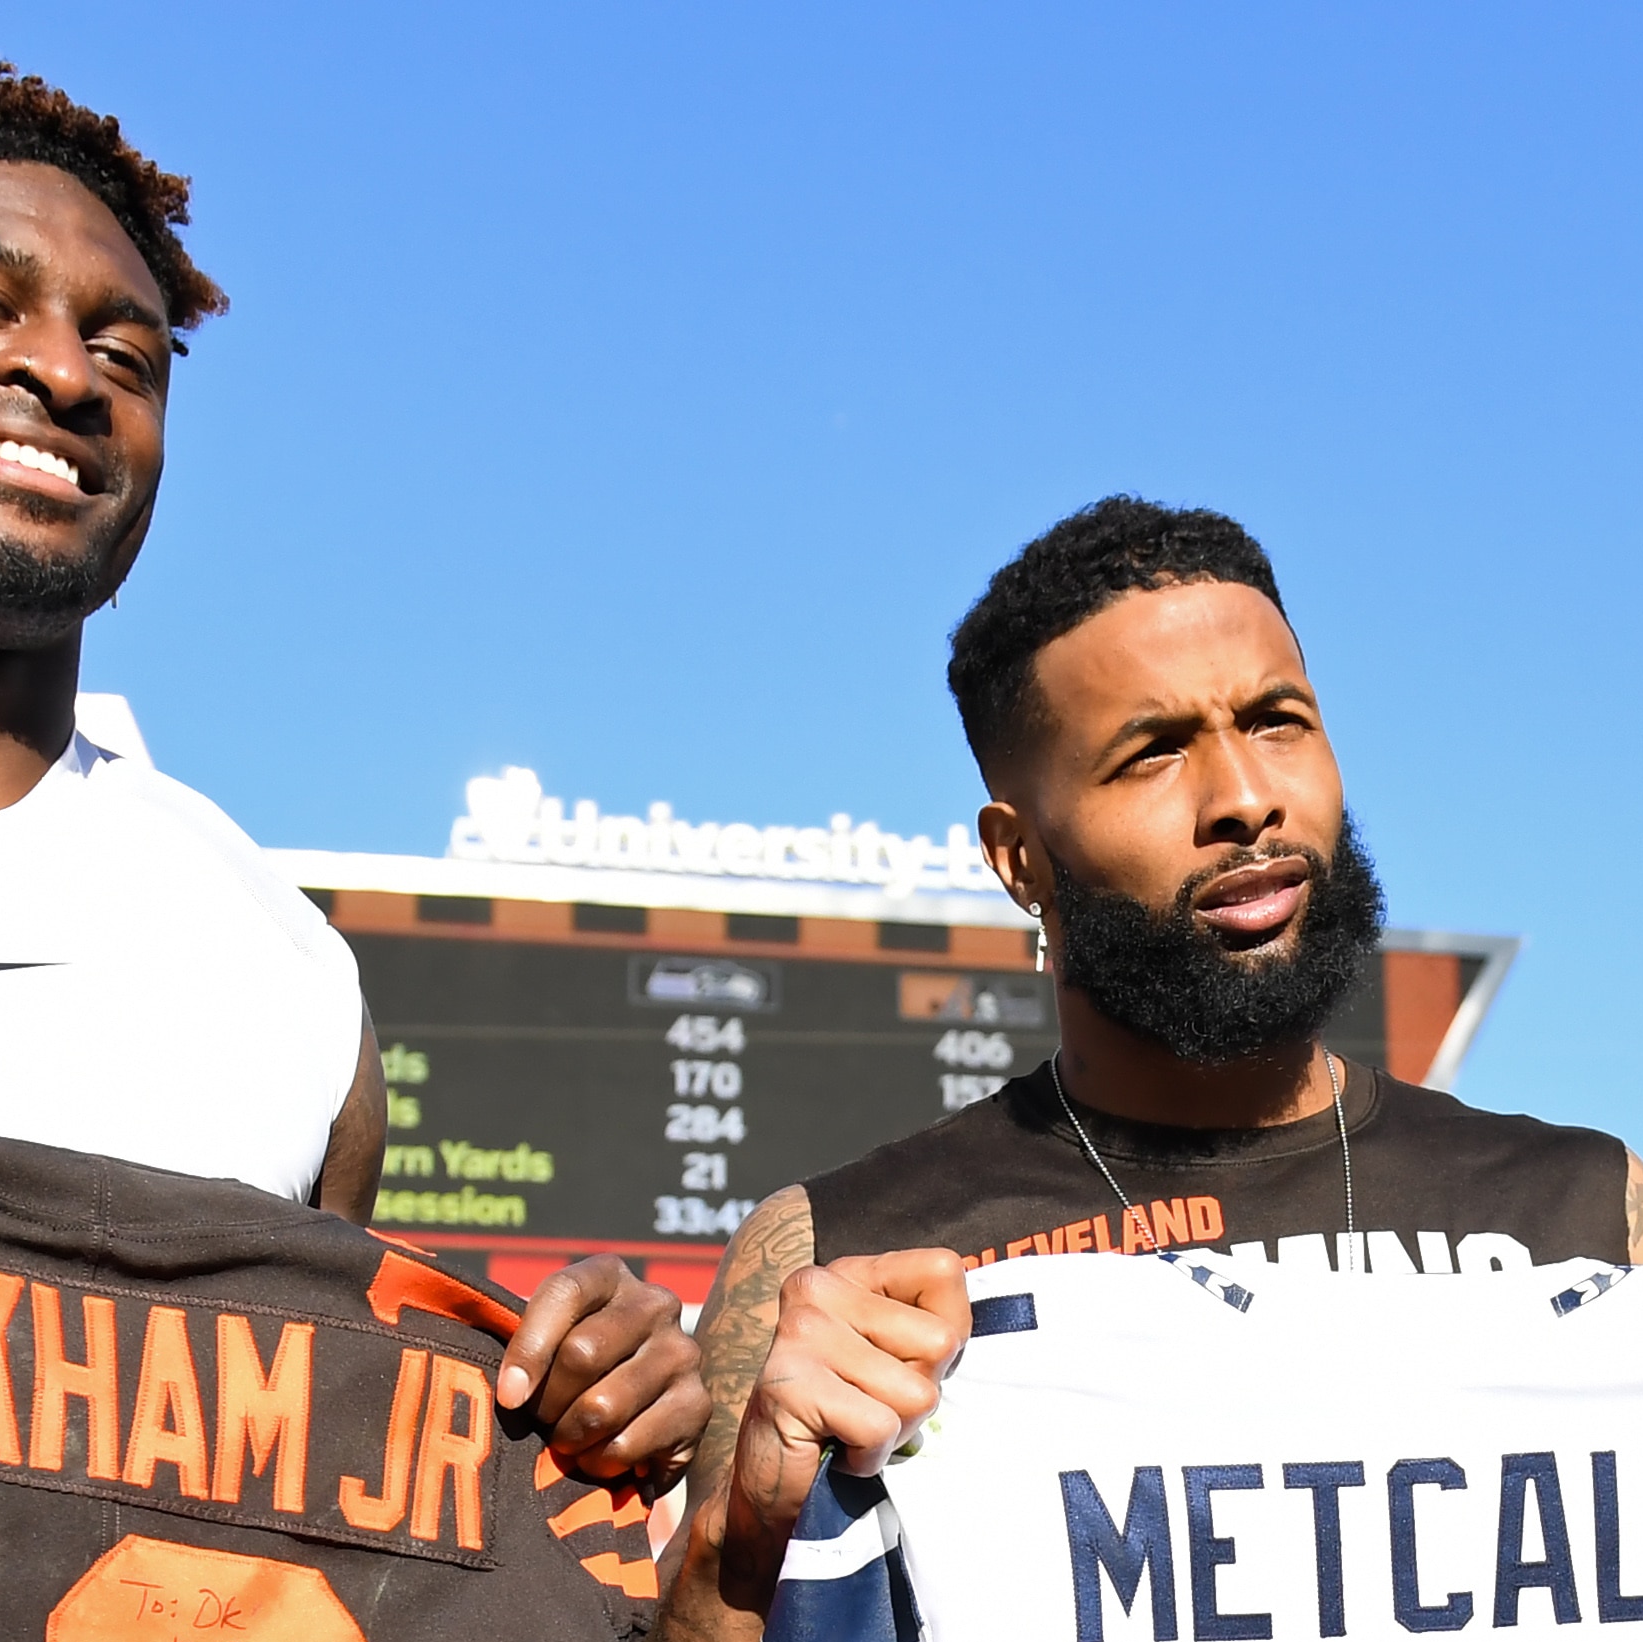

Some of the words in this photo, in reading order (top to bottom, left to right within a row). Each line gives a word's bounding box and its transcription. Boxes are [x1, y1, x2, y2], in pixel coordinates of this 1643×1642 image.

[541, 797, 931, 898] University
[665, 1014, 747, 1055] 454
[933, 1030, 1014, 1070] 406
[670, 1059, 743, 1099] 170
[664, 1103, 747, 1144] 284
[439, 1139, 555, 1184] Yards
[681, 1152, 729, 1191] 21
[338, 1351, 499, 1551] JR
